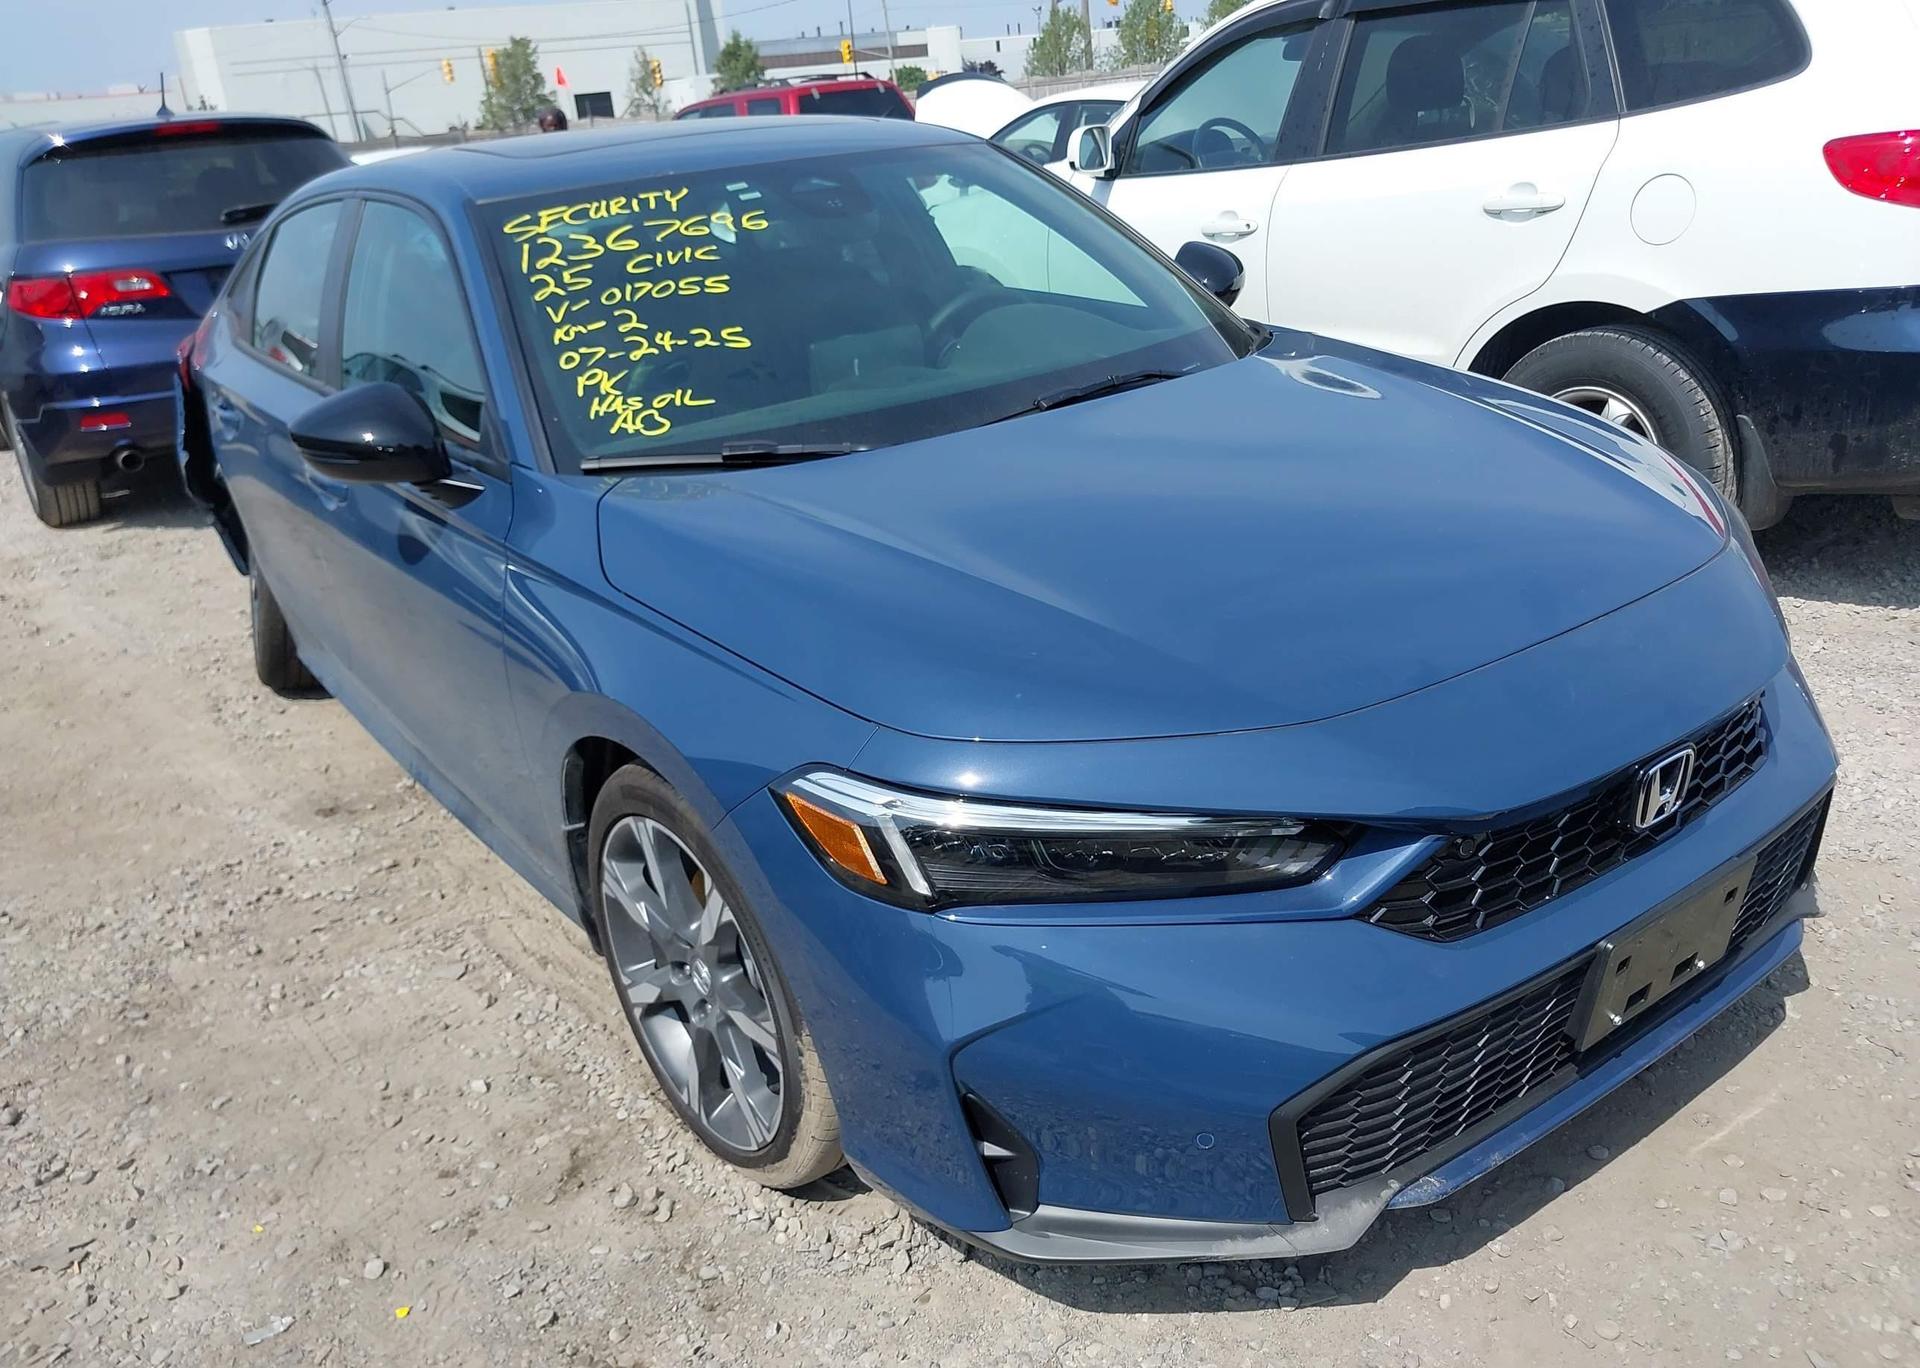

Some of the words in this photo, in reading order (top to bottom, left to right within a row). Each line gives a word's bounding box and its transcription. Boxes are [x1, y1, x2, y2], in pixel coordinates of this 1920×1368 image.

[503, 187, 688, 242] SECURITY
[530, 264, 593, 301] 25
[626, 245, 720, 273] CIVIC
[577, 368, 629, 397] PK
[589, 395, 644, 420] HAS
